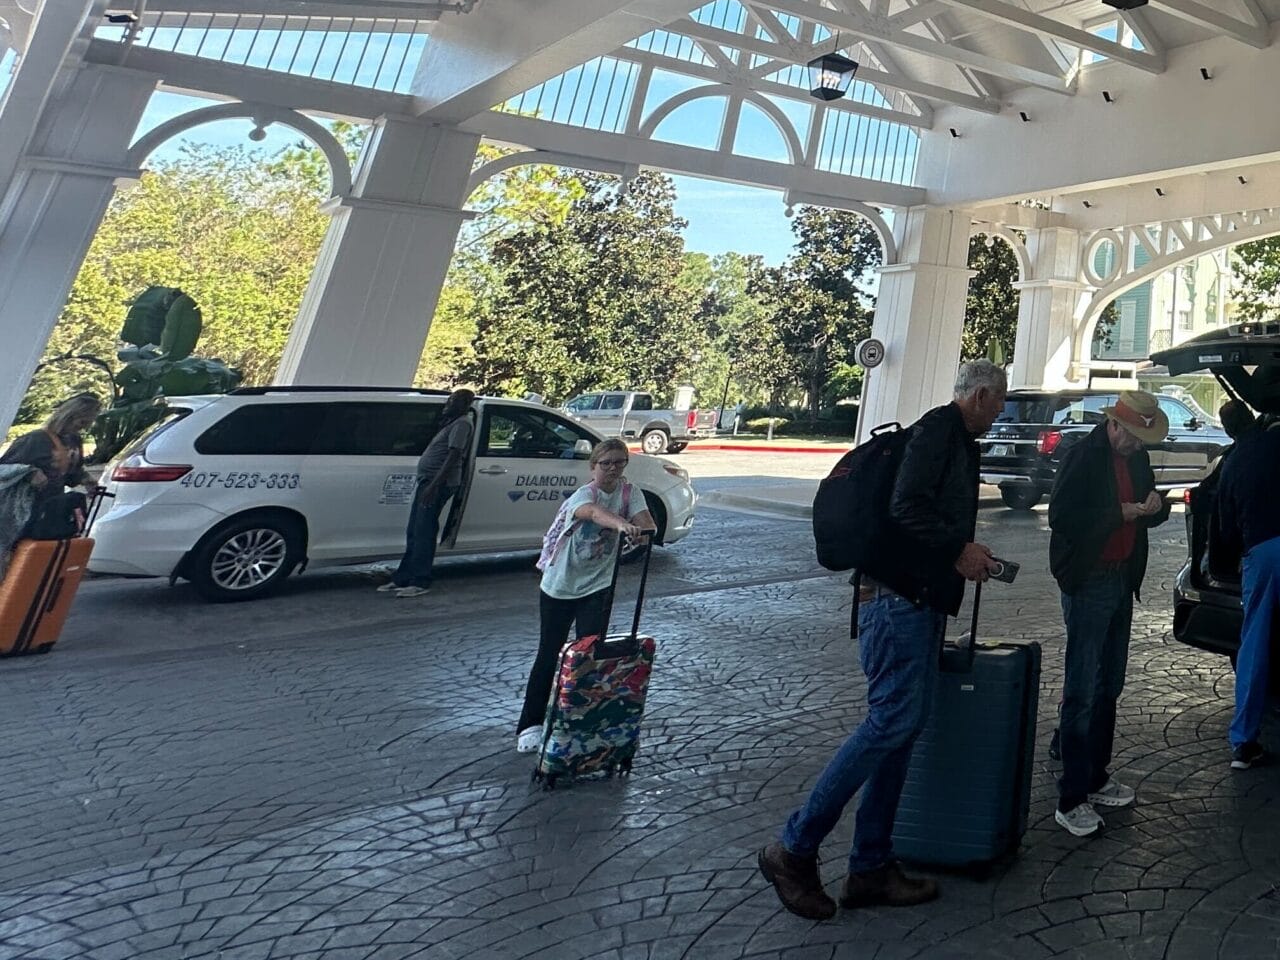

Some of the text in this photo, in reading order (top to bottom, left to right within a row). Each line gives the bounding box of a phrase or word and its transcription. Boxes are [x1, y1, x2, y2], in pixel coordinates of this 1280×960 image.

[180, 472, 302, 489] 407-523-333
[515, 475, 577, 487] DIAMOND
[526, 490, 560, 501] CAB
